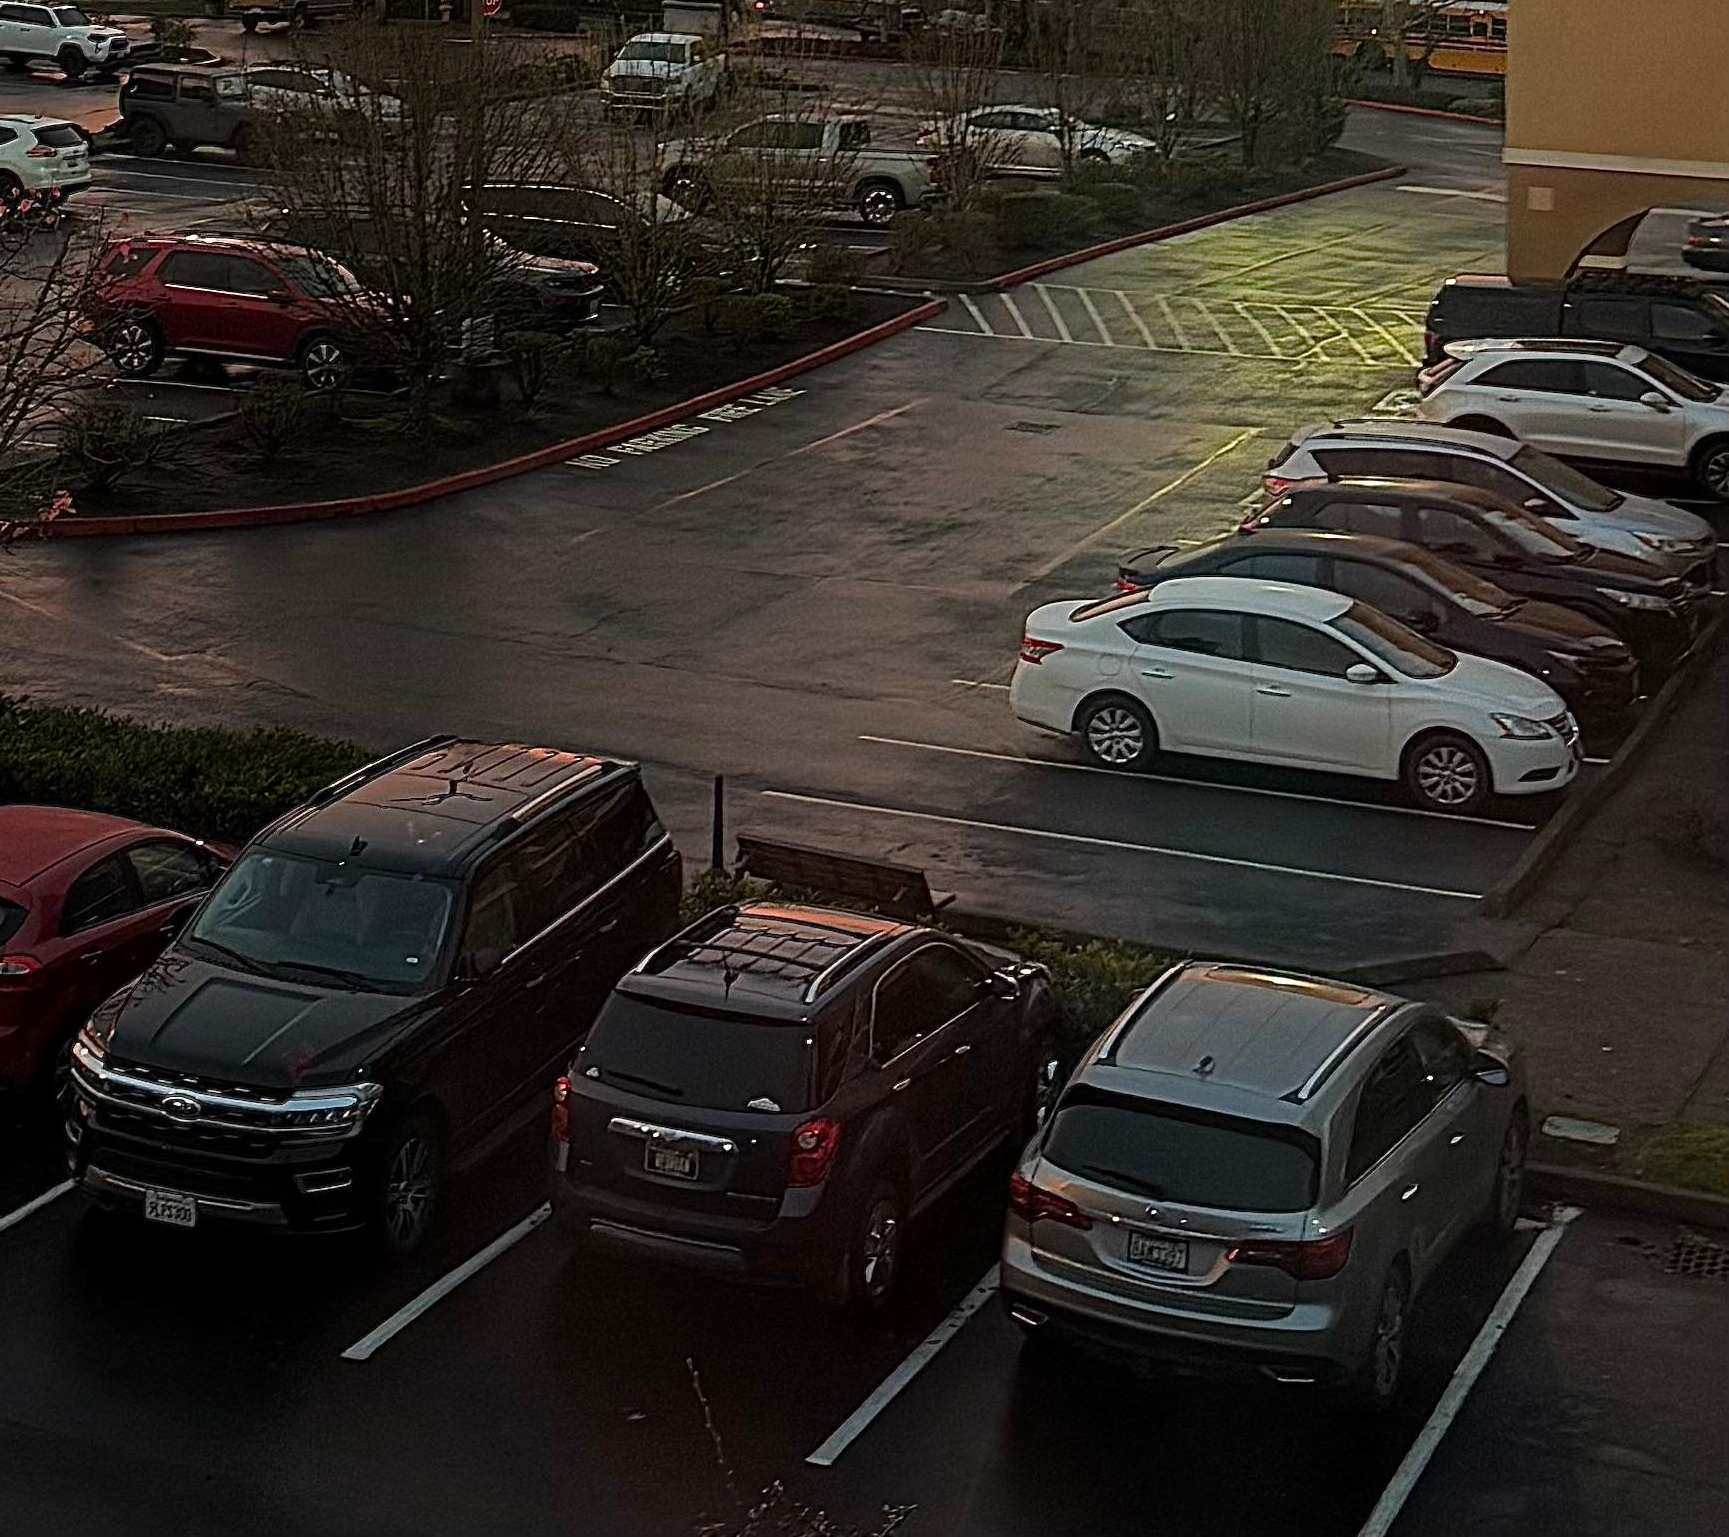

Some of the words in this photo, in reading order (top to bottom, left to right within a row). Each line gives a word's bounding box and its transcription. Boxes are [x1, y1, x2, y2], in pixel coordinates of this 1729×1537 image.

[565, 454, 621, 470] NO
[606, 424, 710, 456] PARKING
[696, 403, 763, 423] FIRE
[738, 386, 808, 406] LANE
